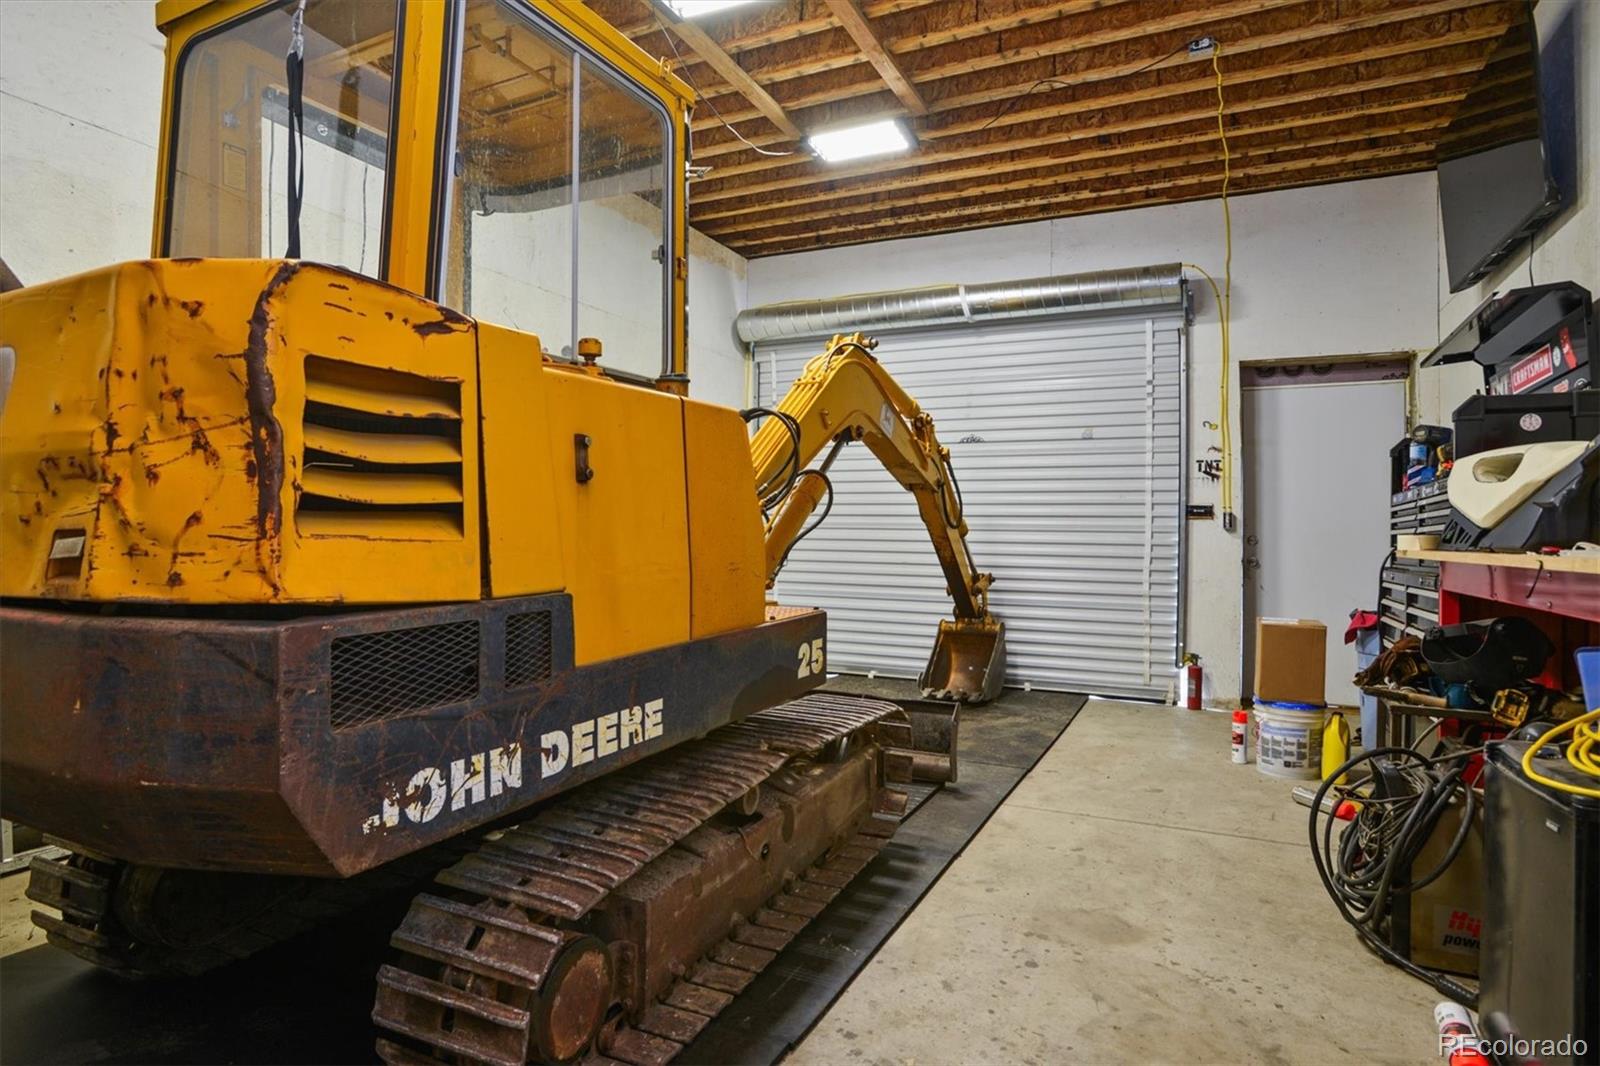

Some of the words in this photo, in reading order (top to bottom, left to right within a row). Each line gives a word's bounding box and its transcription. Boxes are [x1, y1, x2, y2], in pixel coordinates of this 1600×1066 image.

[1512, 352, 1550, 387] CRAFTSMAN
[1196, 459, 1222, 473] TNT
[797, 638, 824, 679] 25
[541, 697, 664, 778] DEERE
